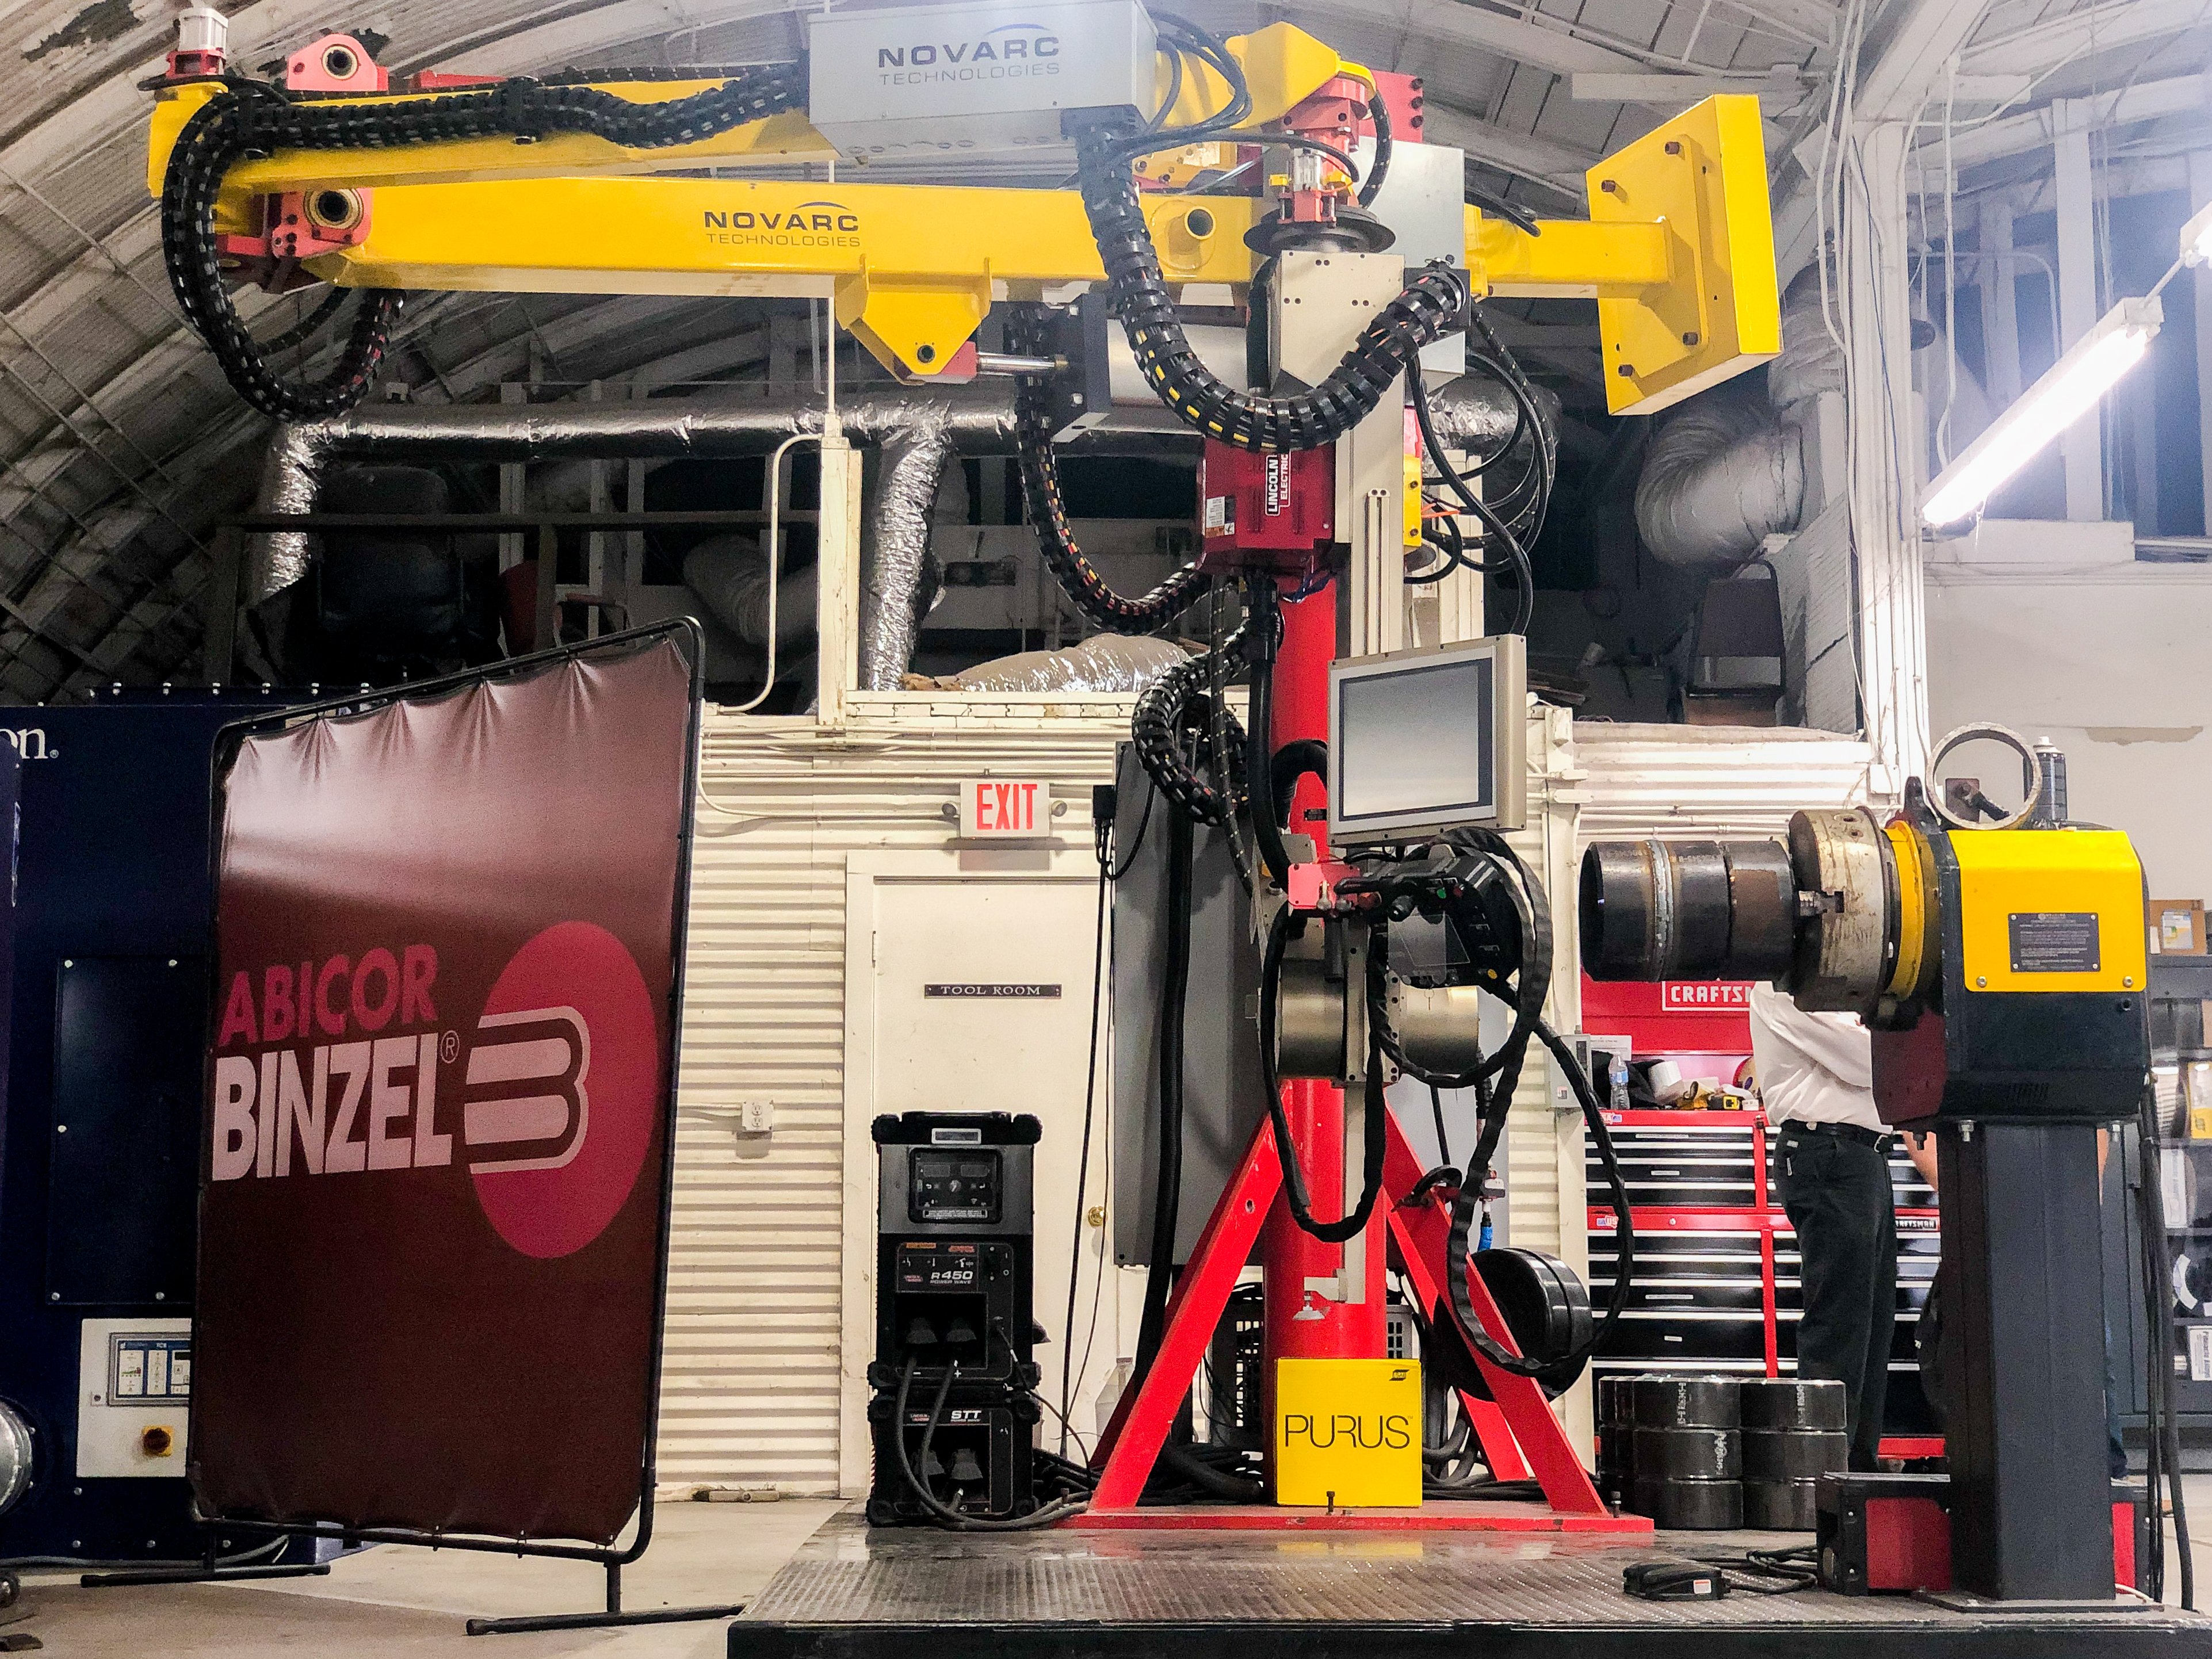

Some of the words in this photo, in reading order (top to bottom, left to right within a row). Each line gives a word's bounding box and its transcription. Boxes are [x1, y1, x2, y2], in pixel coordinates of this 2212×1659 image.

[878, 37, 1060, 68] NOVARC
[879, 63, 1060, 86] TECHNOLOGIES
[704, 211, 859, 231] NOVARC
[706, 233, 861, 247] TECHNOLOGIES
[1268, 459, 1278, 513] LINCOLN
[1280, 454, 1289, 500] ELECTRIC
[977, 783, 1038, 830] EXIT
[217, 943, 440, 1048] ABICOR
[941, 986, 986, 995] TOOL
[994, 986, 1040, 995] ROOM
[212, 1032, 453, 1182] BINZEL
[931, 1270, 973, 1280] R450
[950, 1409, 982, 1420] STT
[1285, 1414, 1411, 1449] PURUS
